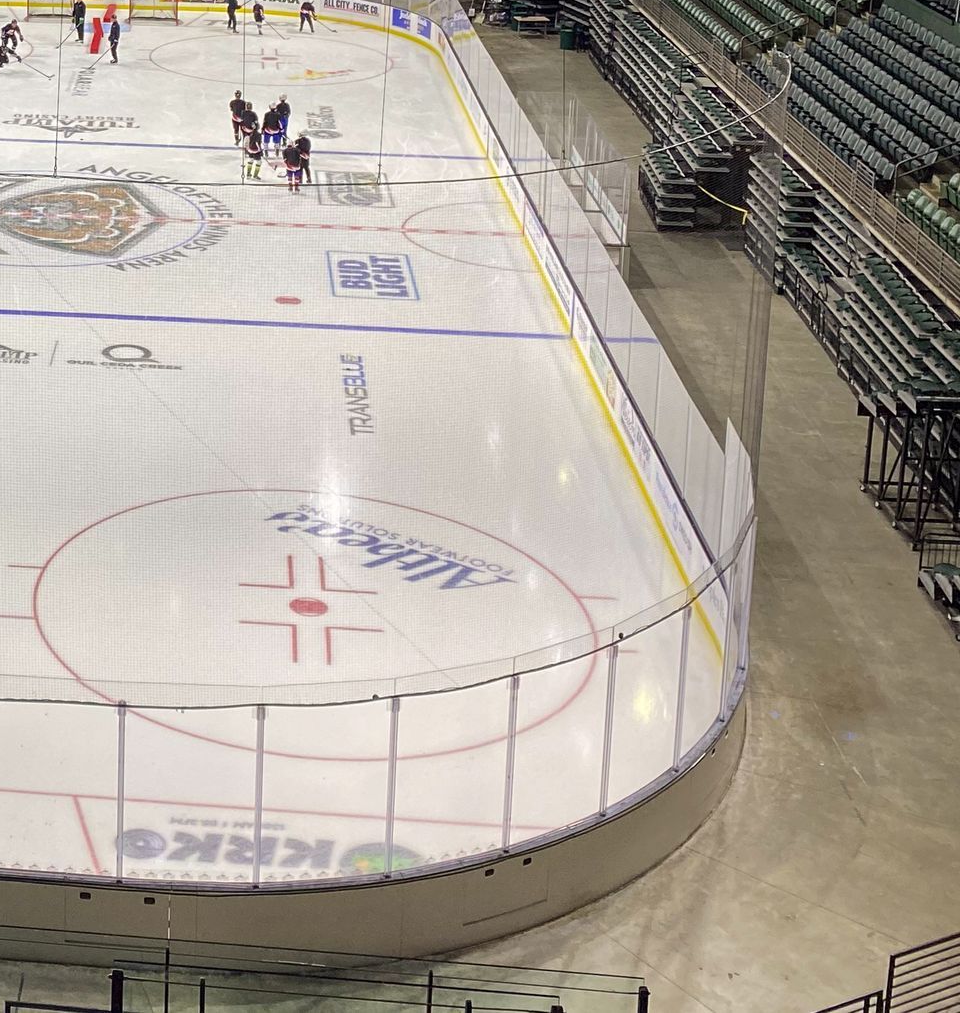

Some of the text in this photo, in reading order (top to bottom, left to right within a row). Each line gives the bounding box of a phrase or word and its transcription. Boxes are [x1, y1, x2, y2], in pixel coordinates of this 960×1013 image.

[335, 0, 350, 9] CITY
[353, 2, 370, 14] FENCE
[202, 198, 233, 218] THE
[106, 250, 189, 272] ARENA
[337, 259, 373, 290] BUD
[369, 255, 409, 297] LIGHT
[340, 354, 375, 436] TRANSBLUE
[296, 504, 516, 578] FOOTWEAR SOLUTNS
